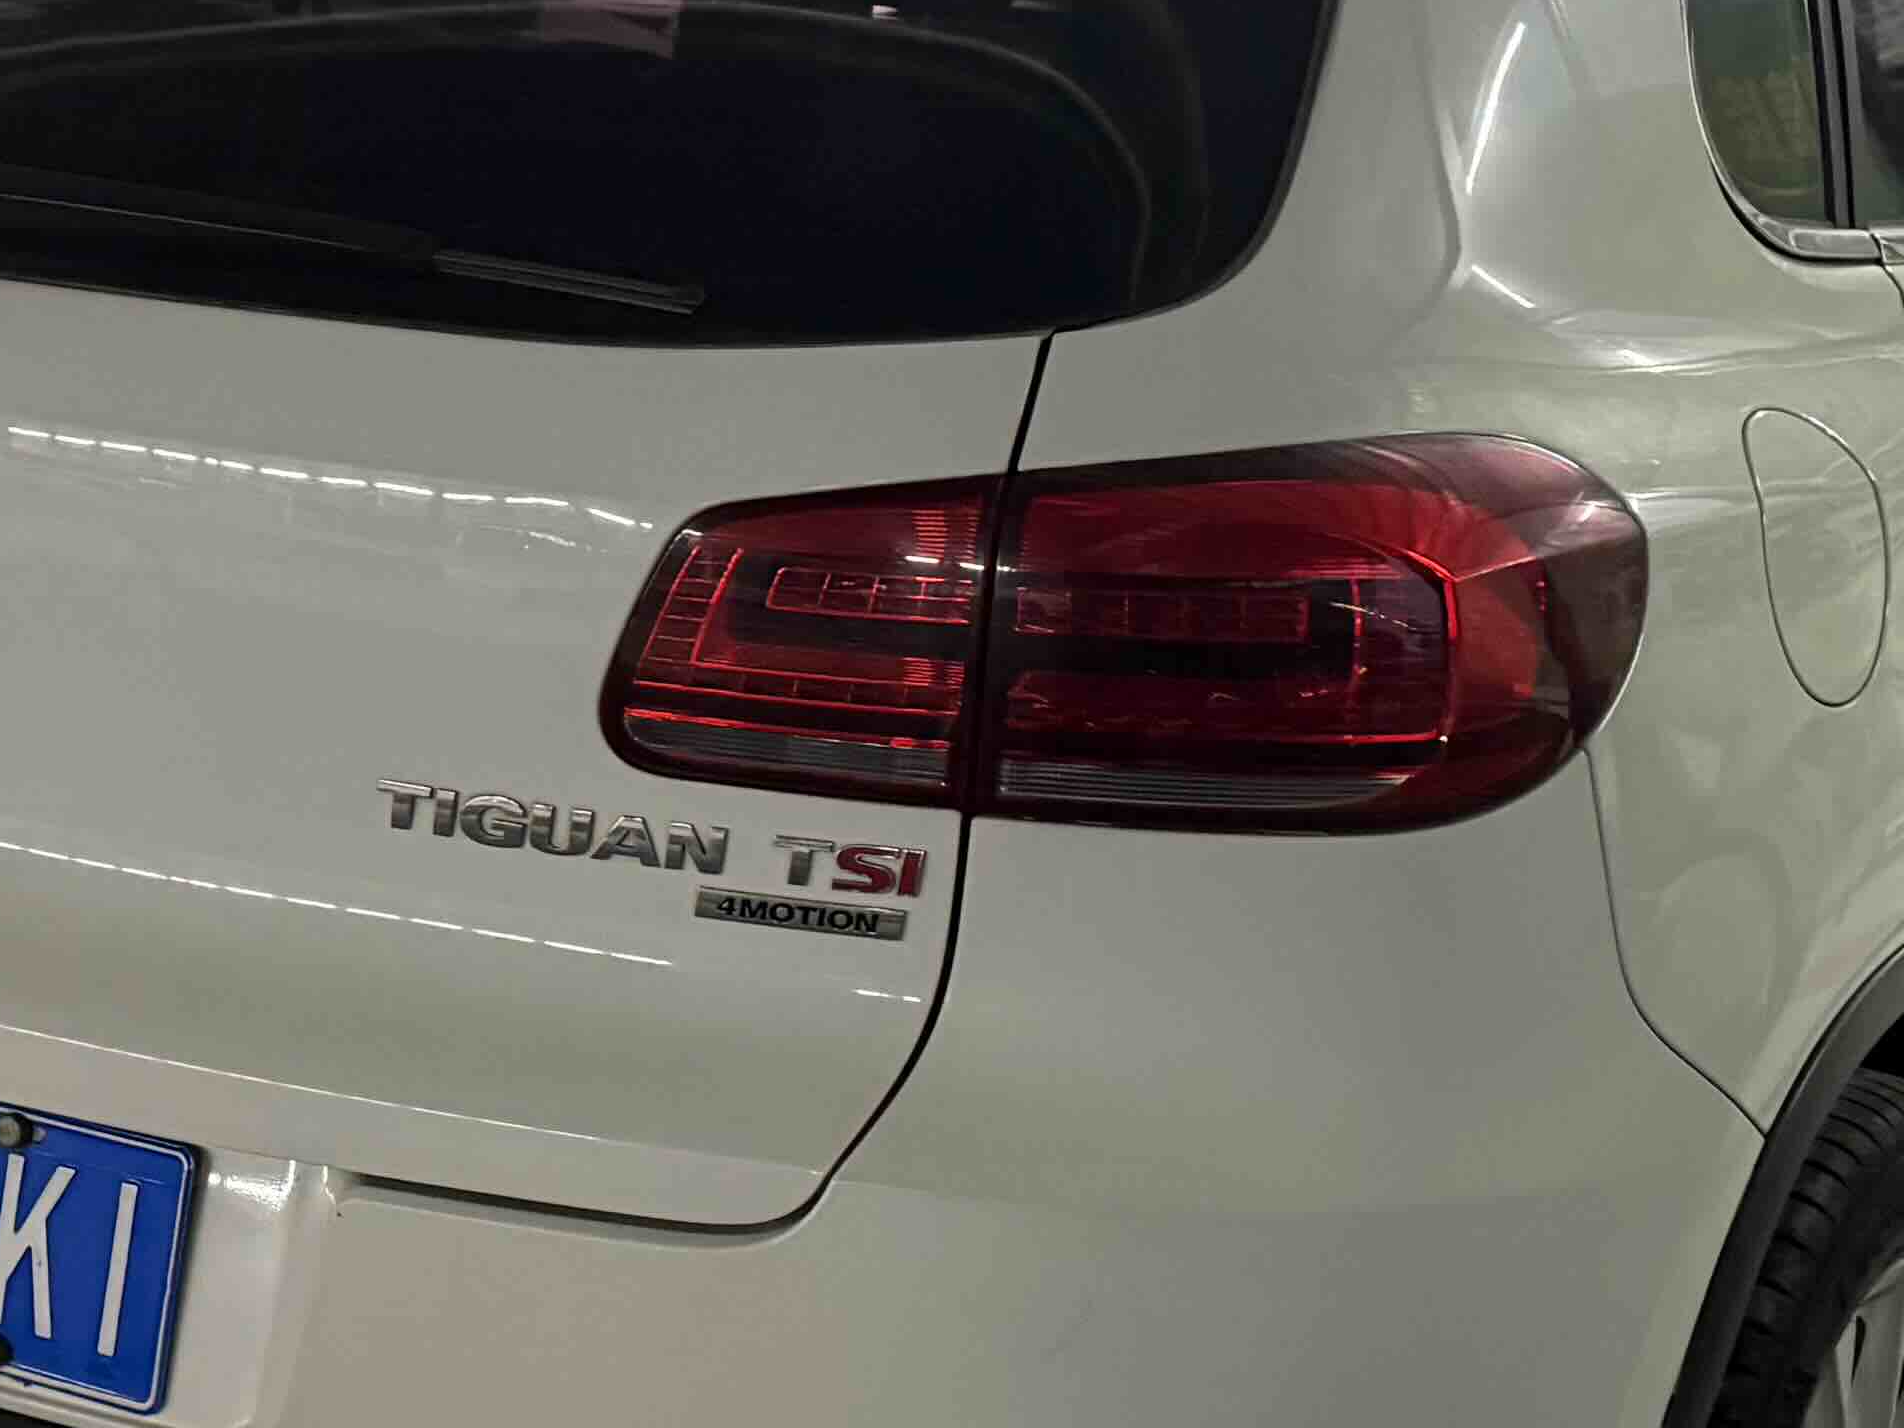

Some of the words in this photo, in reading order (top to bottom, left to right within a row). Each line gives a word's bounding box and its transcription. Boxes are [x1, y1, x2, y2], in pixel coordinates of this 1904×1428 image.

[376, 778, 729, 875] TIGUAN
[773, 834, 926, 898] TSI
[715, 896, 881, 935] 4MOTION
